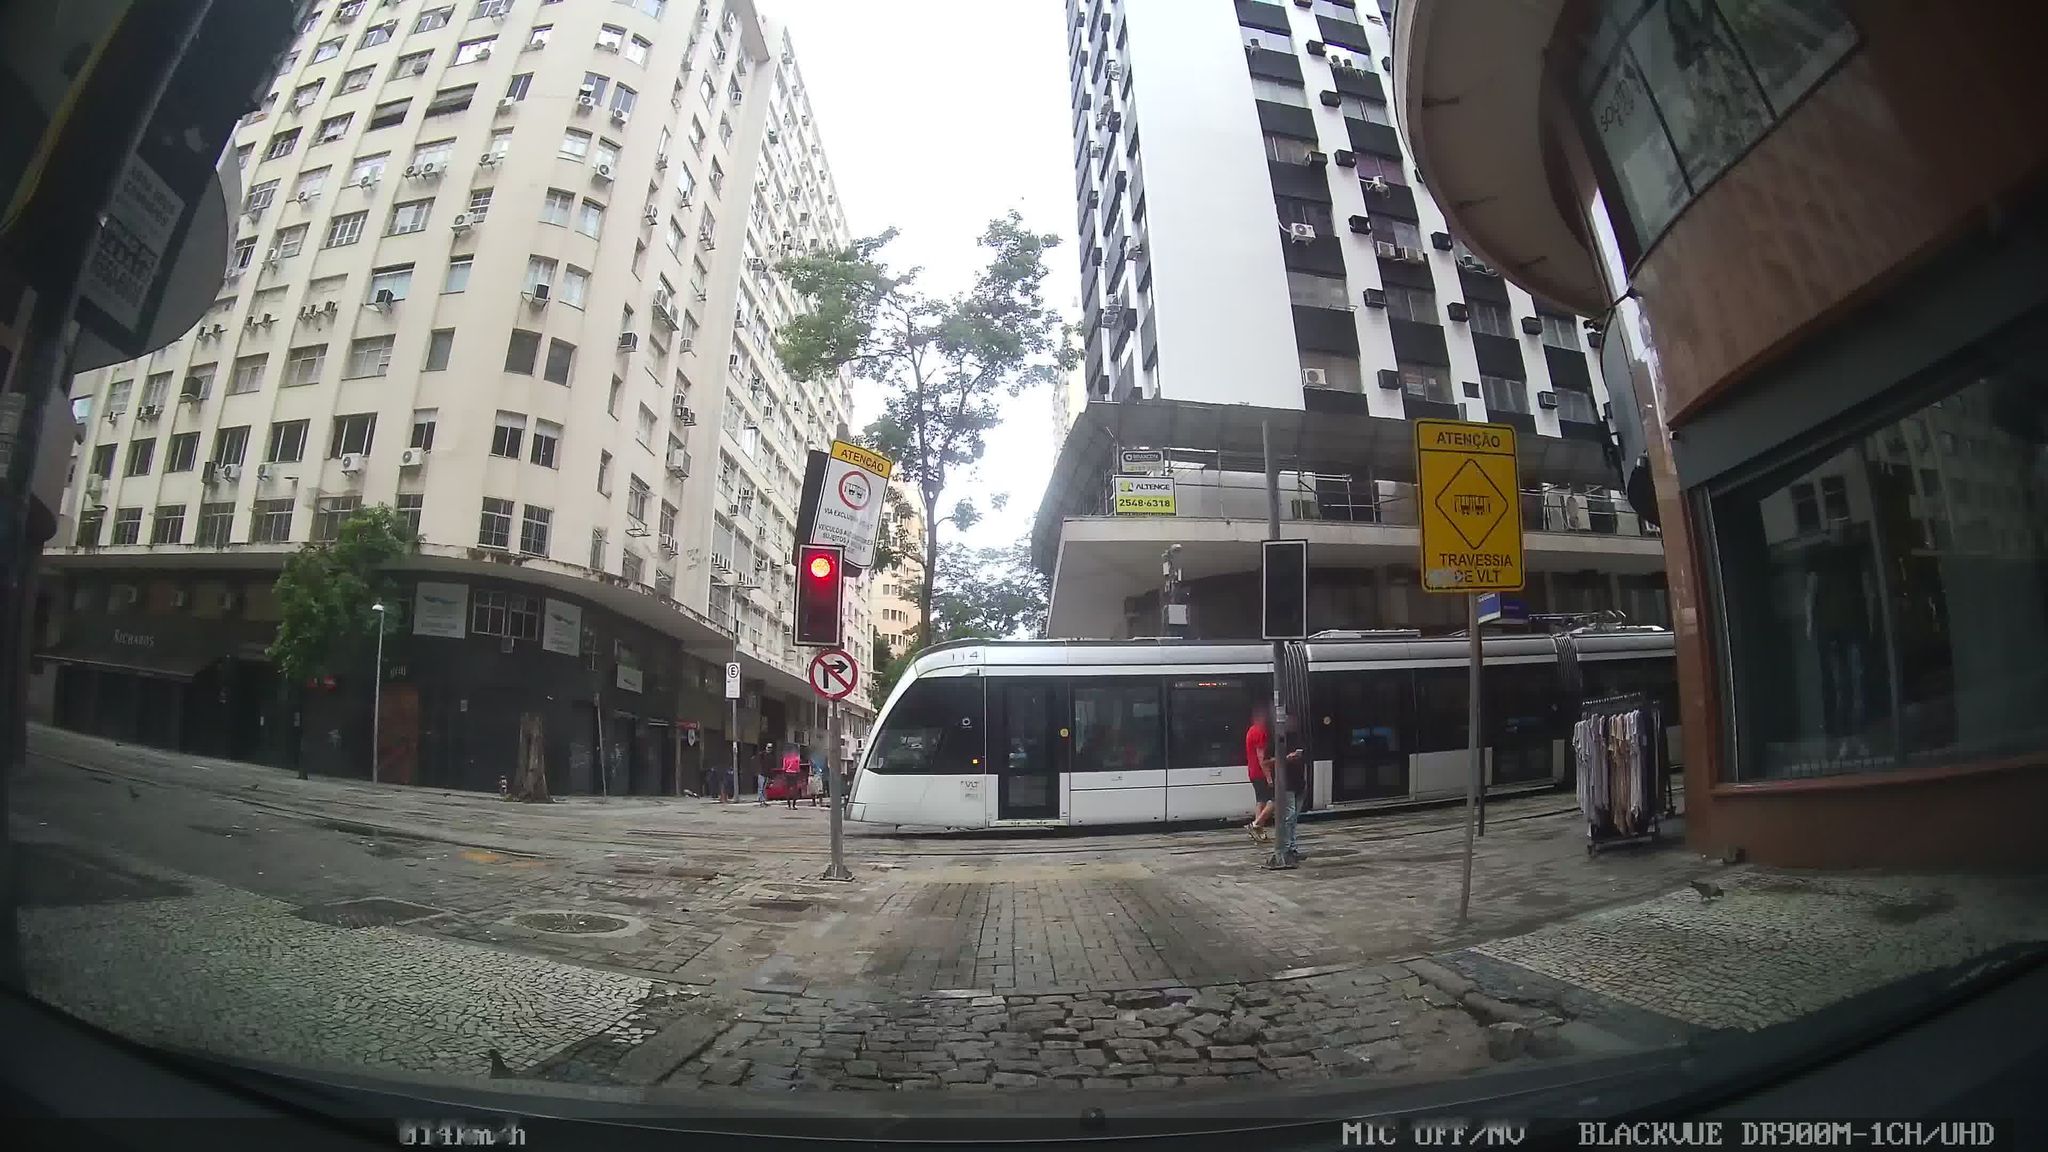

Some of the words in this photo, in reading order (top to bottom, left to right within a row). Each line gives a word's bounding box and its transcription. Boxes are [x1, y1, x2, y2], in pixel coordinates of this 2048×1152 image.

[1437, 431, 1501, 449] ATENÇÃO
[1439, 553, 1513, 567] TRAVESSIA
[1477, 570, 1502, 583] VLT
